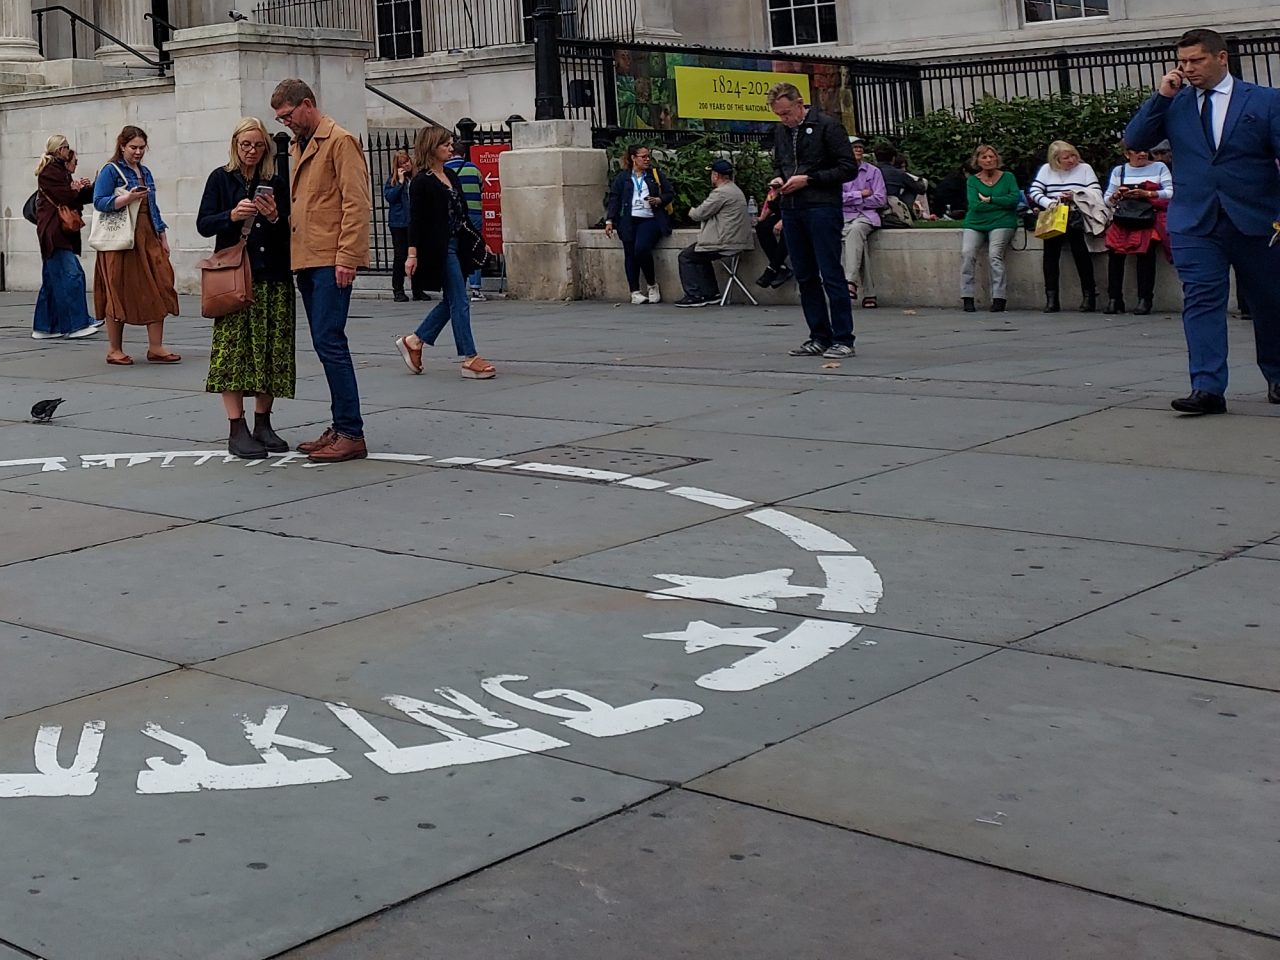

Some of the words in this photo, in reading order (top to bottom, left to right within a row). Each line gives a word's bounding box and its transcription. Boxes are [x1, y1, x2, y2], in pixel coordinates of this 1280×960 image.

[713, 75, 770, 99] 1824-202
[698, 102, 708, 110] 200
[709, 102, 726, 111] YEARS
[727, 103, 734, 111] OF
[735, 103, 745, 112] THE
[745, 103, 771, 113] NATIONAL
[481, 192, 500, 200] ntran
